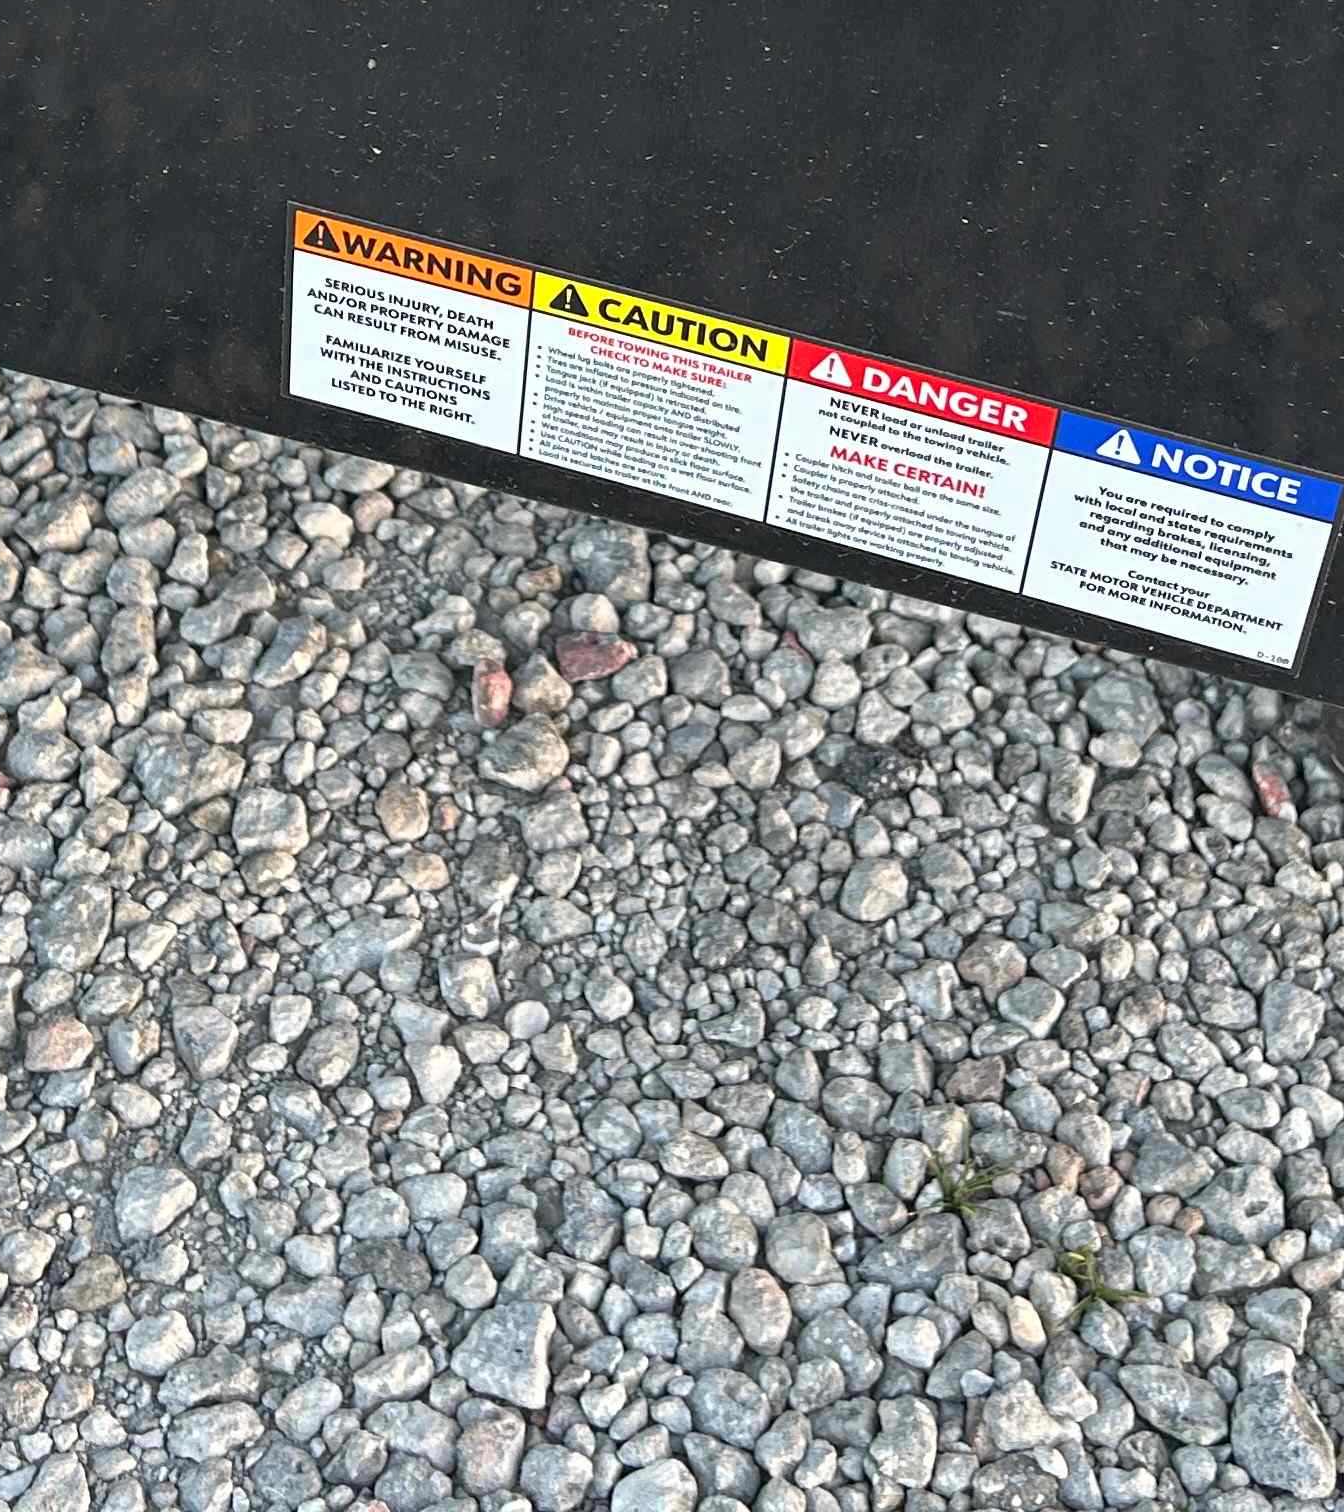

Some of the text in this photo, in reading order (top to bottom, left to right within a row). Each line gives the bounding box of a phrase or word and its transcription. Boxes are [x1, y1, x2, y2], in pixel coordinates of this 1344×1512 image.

[342, 230, 521, 296] WARNING
[306, 287, 511, 349] AND/OR PROPERTY DAMAGE
[324, 276, 494, 330] SERIOUS INJURY, DEATH
[598, 298, 768, 362] CAUTION
[313, 303, 502, 361] CAN RESULT FROM MISUSE.
[325, 333, 487, 385] FAMILIARIZE YOURSELF
[567, 326, 753, 384] BEFORE TOWING THIS TRAILER
[319, 346, 491, 401] WITH THE INSTRUCTIONS
[349, 369, 458, 406] AND CAUTIONS
[589, 345, 726, 389] CHECK TO MAKE SURE:
[330, 376, 476, 425] LISTED TO THE RIGHT.
[829, 396, 1005, 453] NEVER load or unload trailer
[862, 366, 1028, 432] DANGER
[817, 408, 1010, 466] not coupled to the towing vehicle.
[828, 424, 994, 480] NEVER overload the trailer.
[829, 444, 986, 499] MAKE CERTAIN!
[1151, 443, 1301, 505] NOTICE
[1073, 493, 1293, 559] with local and state requirements
[1088, 511, 1271, 568] regarding brakes, licensing,
[1098, 485, 1276, 544] You are required to comply
[1078, 520, 1277, 581] and any additional equipment
[1099, 537, 1249, 586] that may be necessary.
[1049, 560, 1284, 631] STATE MOTOR VEHICLE DEPARTMENT
[1078, 579, 1247, 634] FOR MORE INFORMATION.
[1127, 569, 1211, 599] Contact your
